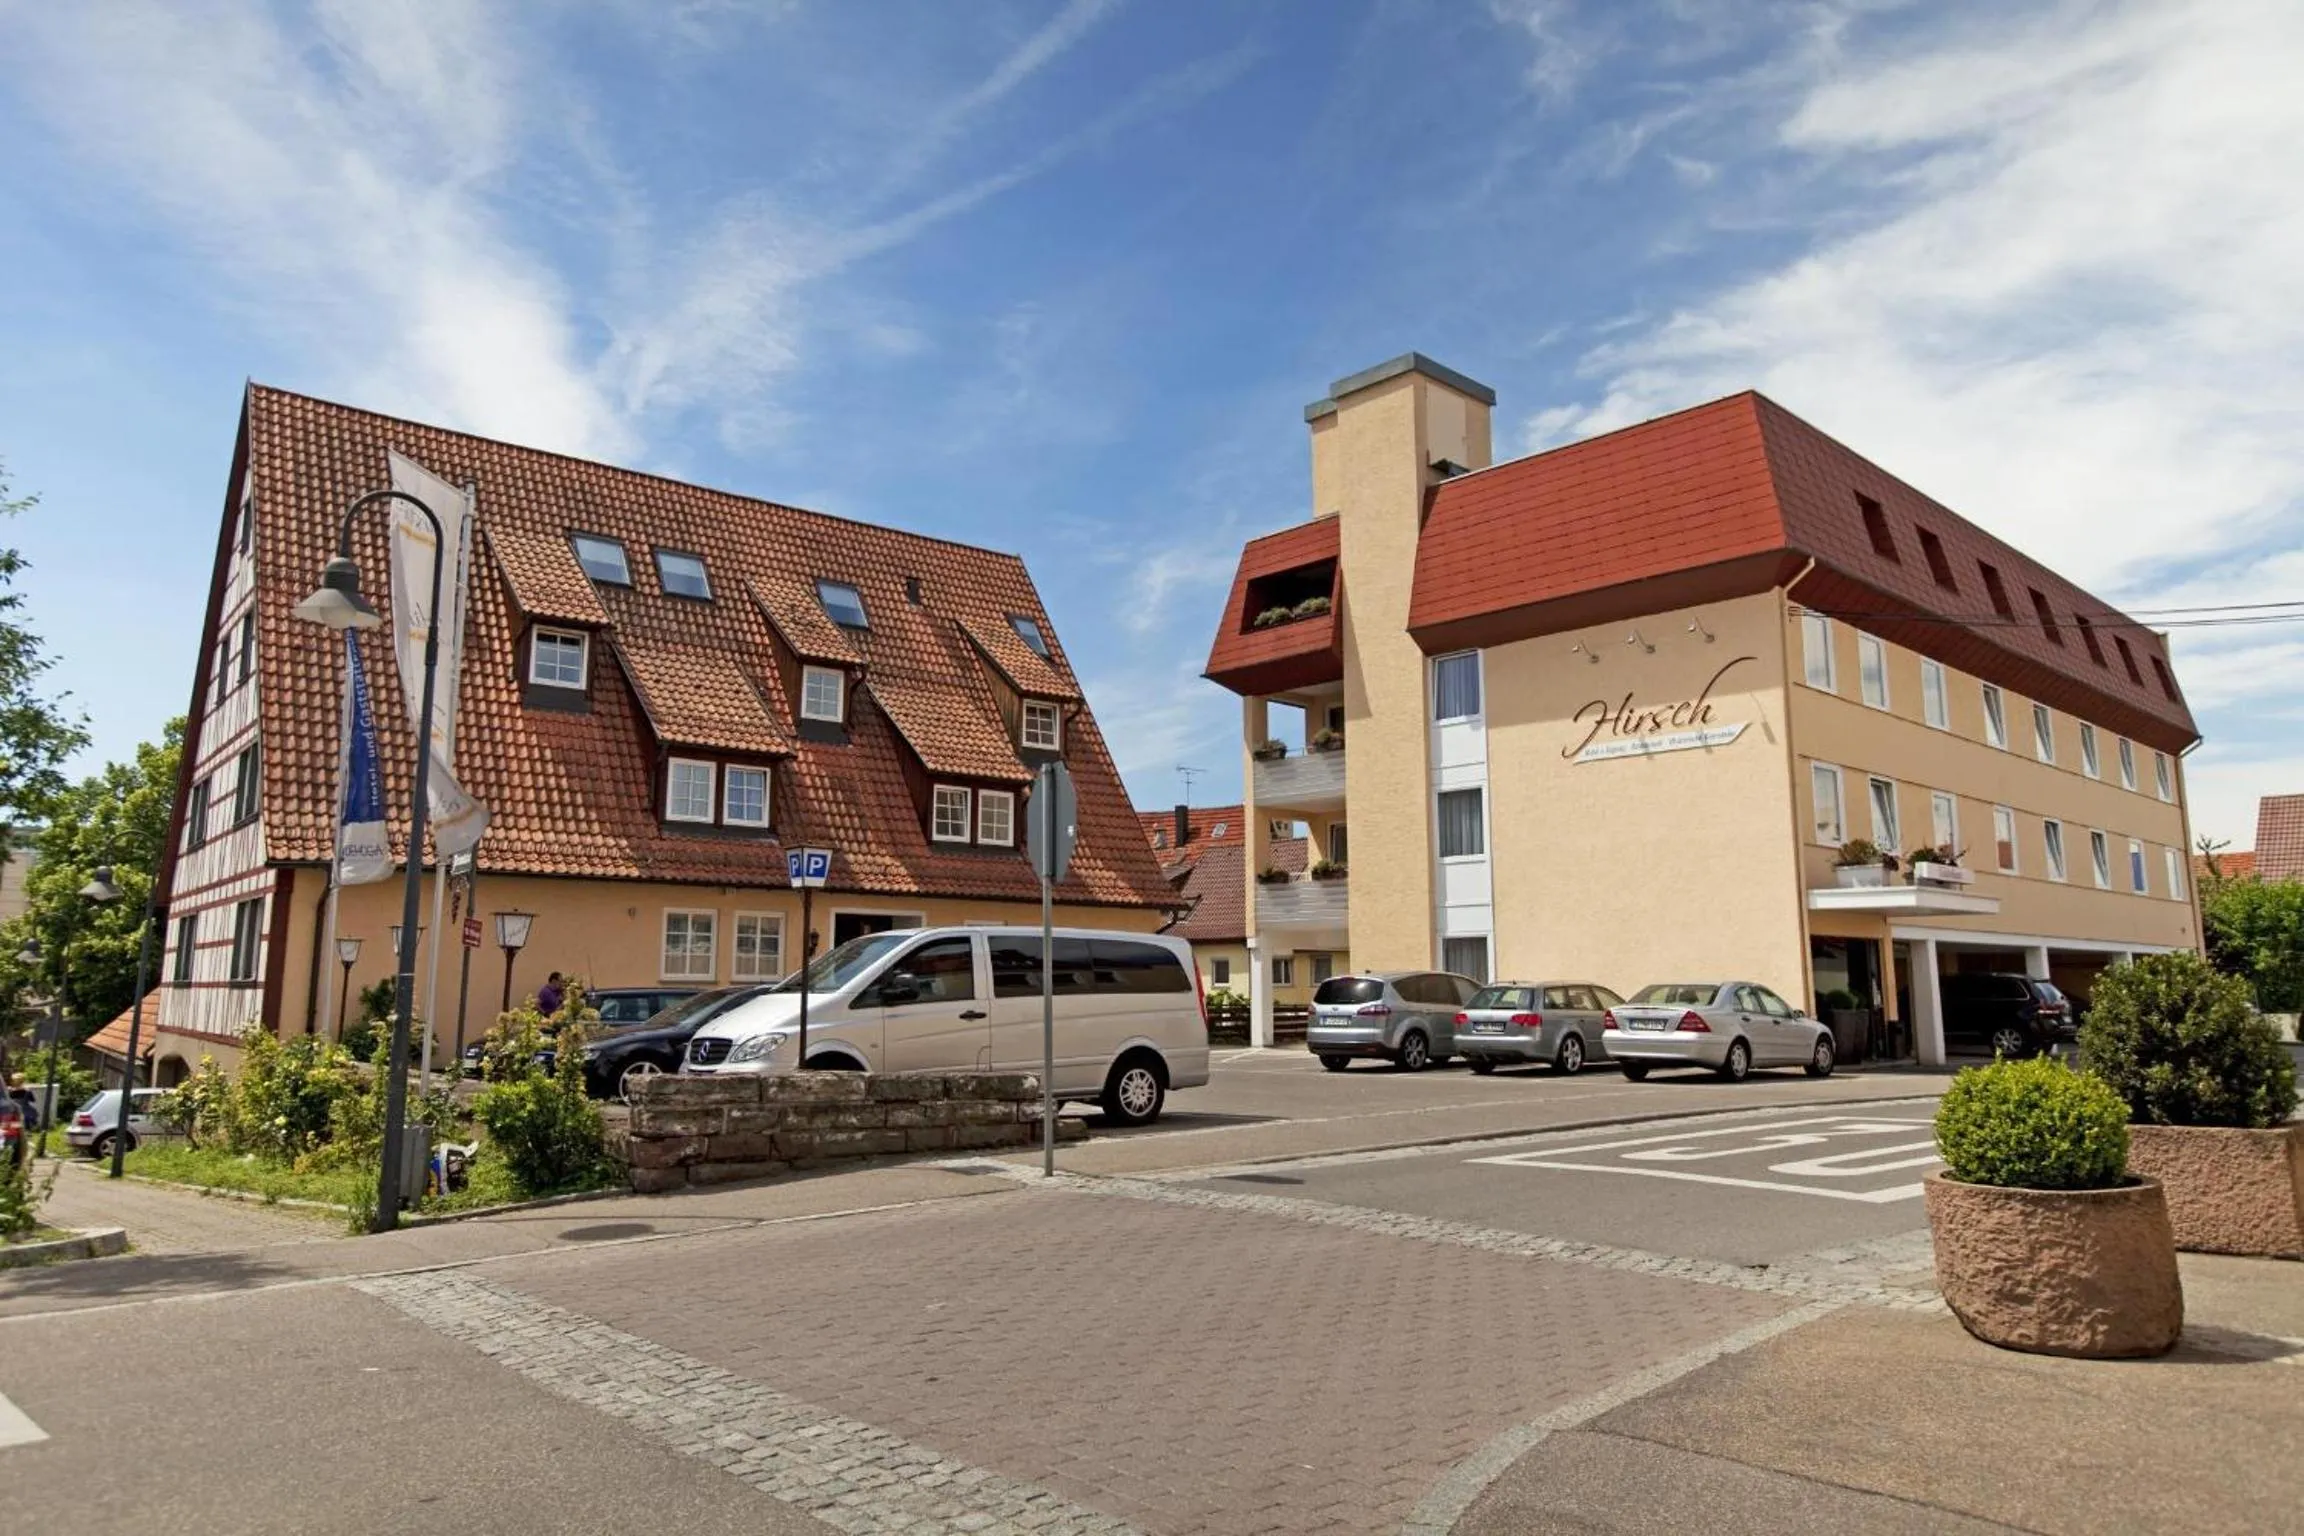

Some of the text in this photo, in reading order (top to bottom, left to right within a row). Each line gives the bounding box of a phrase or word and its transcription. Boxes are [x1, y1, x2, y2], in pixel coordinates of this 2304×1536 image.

[1562, 656, 1757, 758] Hirsch
[362, 732, 375, 758] und
[791, 857, 799, 876] P
[808, 856, 824, 875] P
